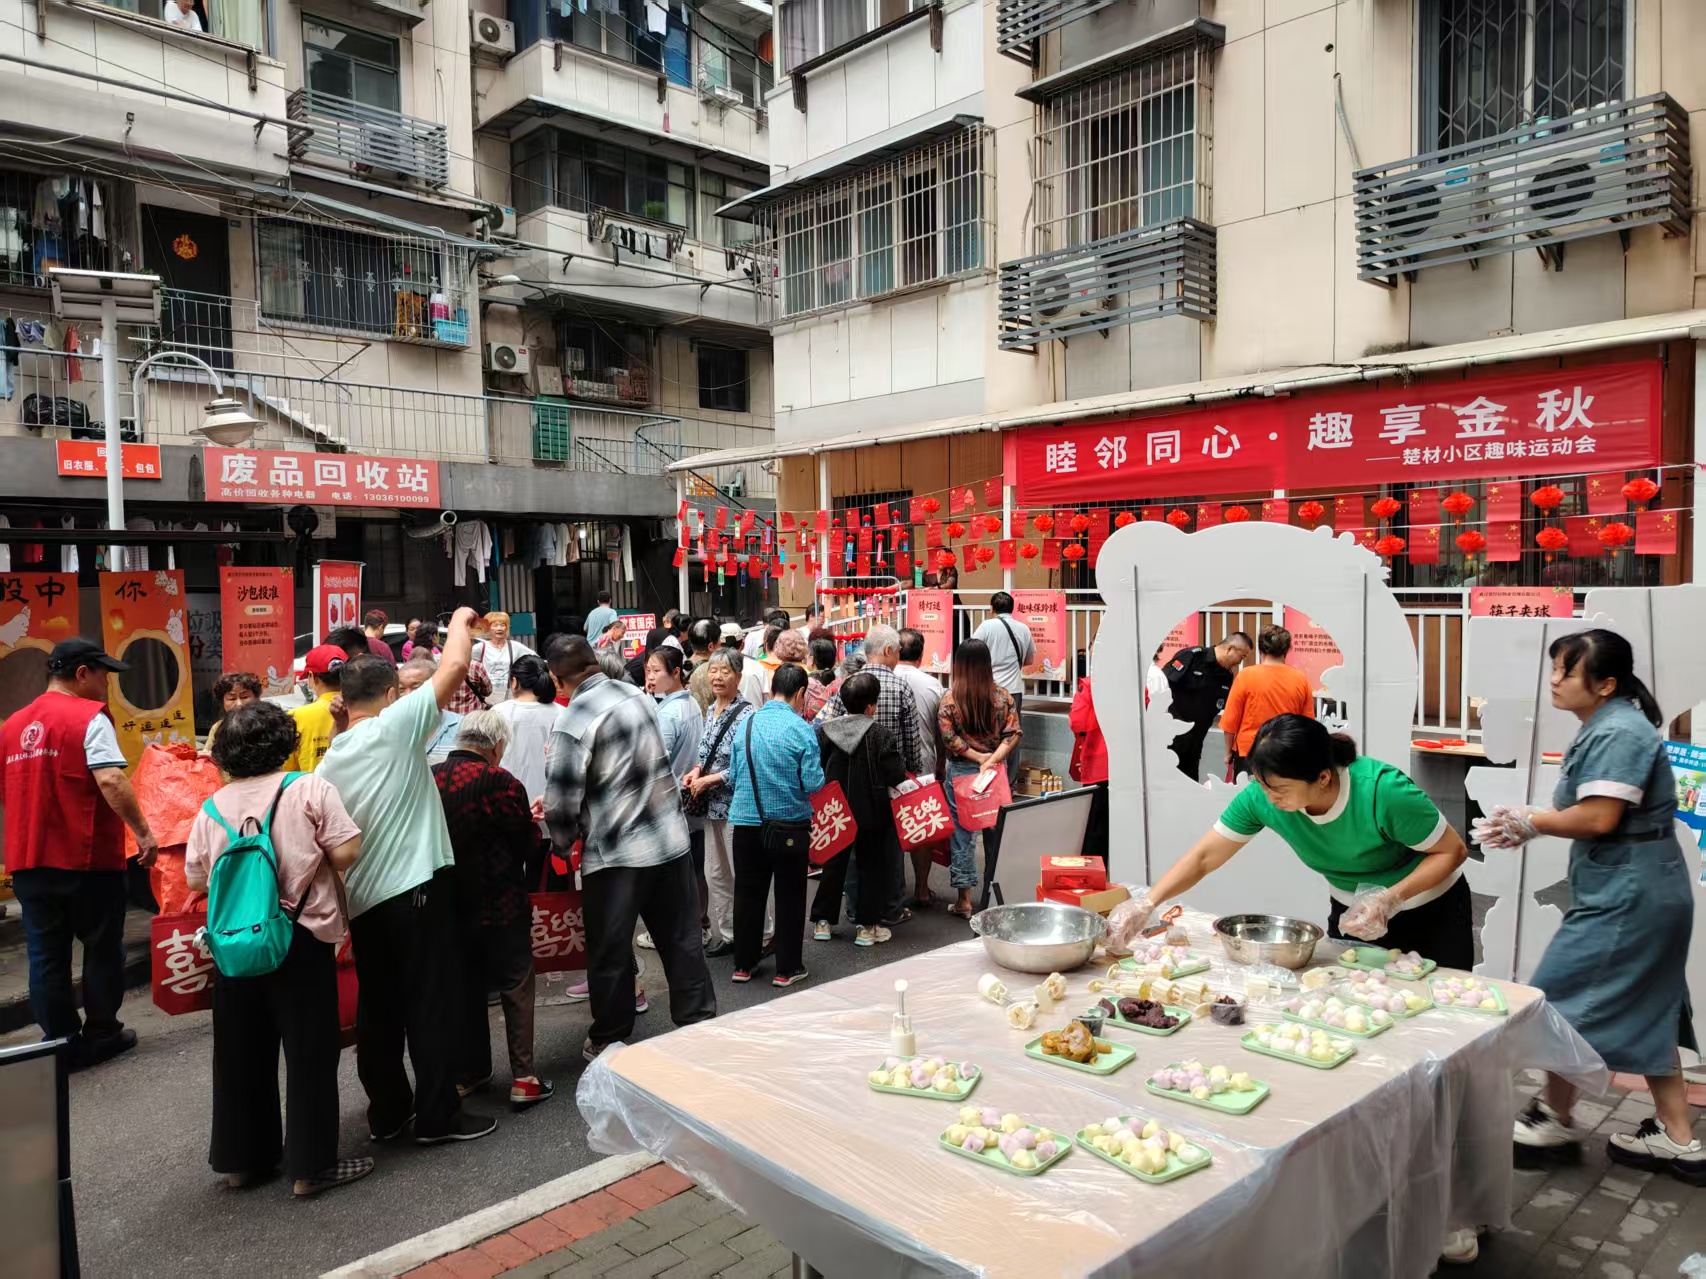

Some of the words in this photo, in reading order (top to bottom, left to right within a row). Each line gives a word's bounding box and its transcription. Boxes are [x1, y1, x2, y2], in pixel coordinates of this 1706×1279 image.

[220, 453, 429, 492] 废品回收站
[220, 487, 316, 499] 高价回收各种电器
[0, 576, 65, 607] 投中
[115, 580, 148, 602] 你
[237, 585, 280, 602] 沙包投准
[1489, 603, 1551, 617] 筷子夹球
